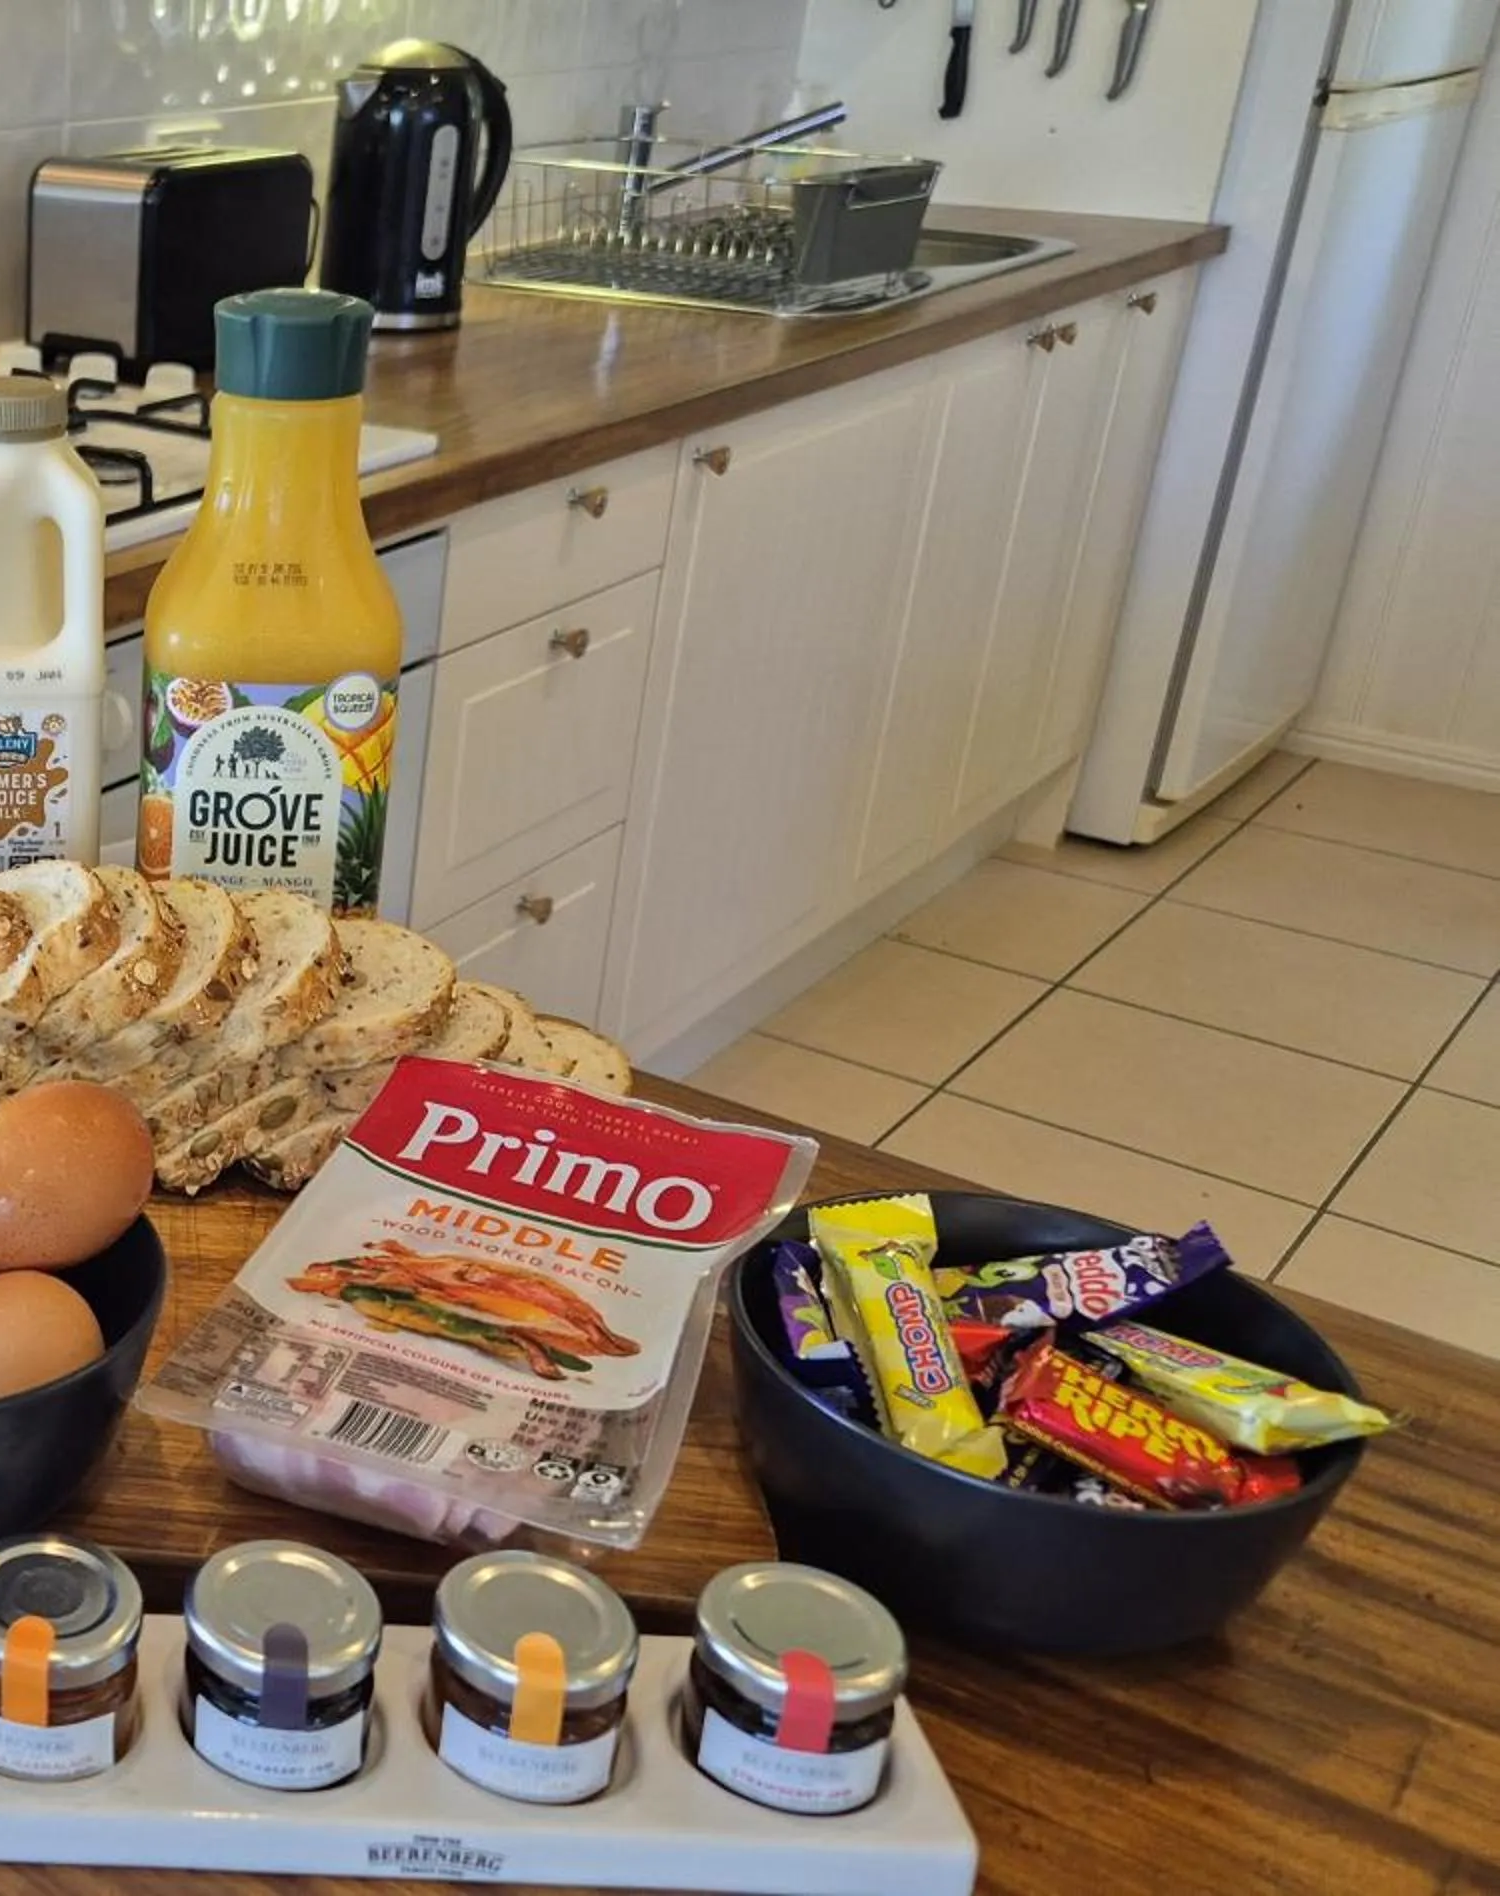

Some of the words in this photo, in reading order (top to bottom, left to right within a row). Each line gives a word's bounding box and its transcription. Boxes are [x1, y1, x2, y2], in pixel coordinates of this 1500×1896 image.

[190, 786, 323, 831] GROVE
[204, 831, 299, 867] JUICE
[396, 1100, 712, 1232] Primo
[407, 1199, 628, 1275] MIDDLE
[453, 1234, 545, 1268] SMOKED
[1074, 1250, 1125, 1315] eddo
[403, 1347, 467, 1376] COLOURS
[888, 1282, 950, 1394] CHOMP
[1051, 1357, 1228, 1463] HERRY
[1053, 1382, 1177, 1465] RIPE
[367, 1846, 504, 1872] BEERENBERG
